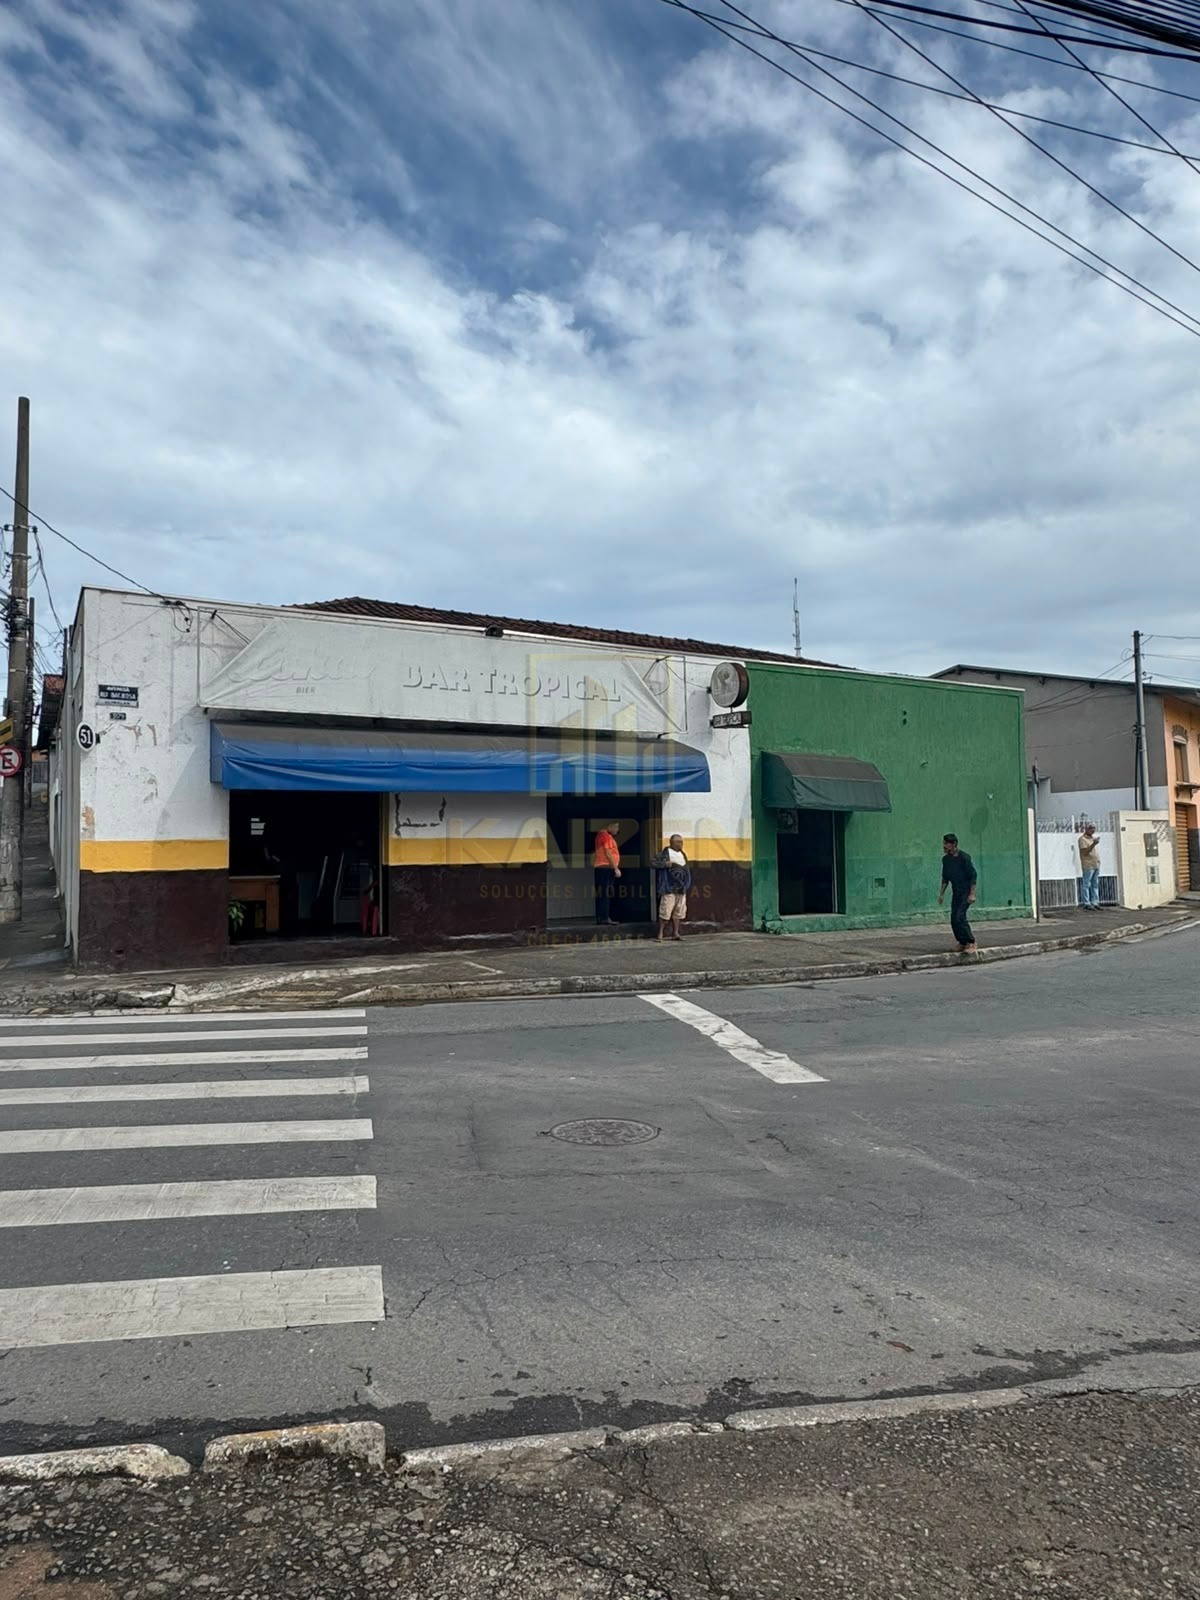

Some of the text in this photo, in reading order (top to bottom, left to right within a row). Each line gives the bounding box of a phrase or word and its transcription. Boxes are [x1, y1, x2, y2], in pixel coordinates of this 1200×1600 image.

[403, 665, 471, 693] BAR
[480, 669, 622, 702] TROPICAL
[80, 729, 92, 745] 51
